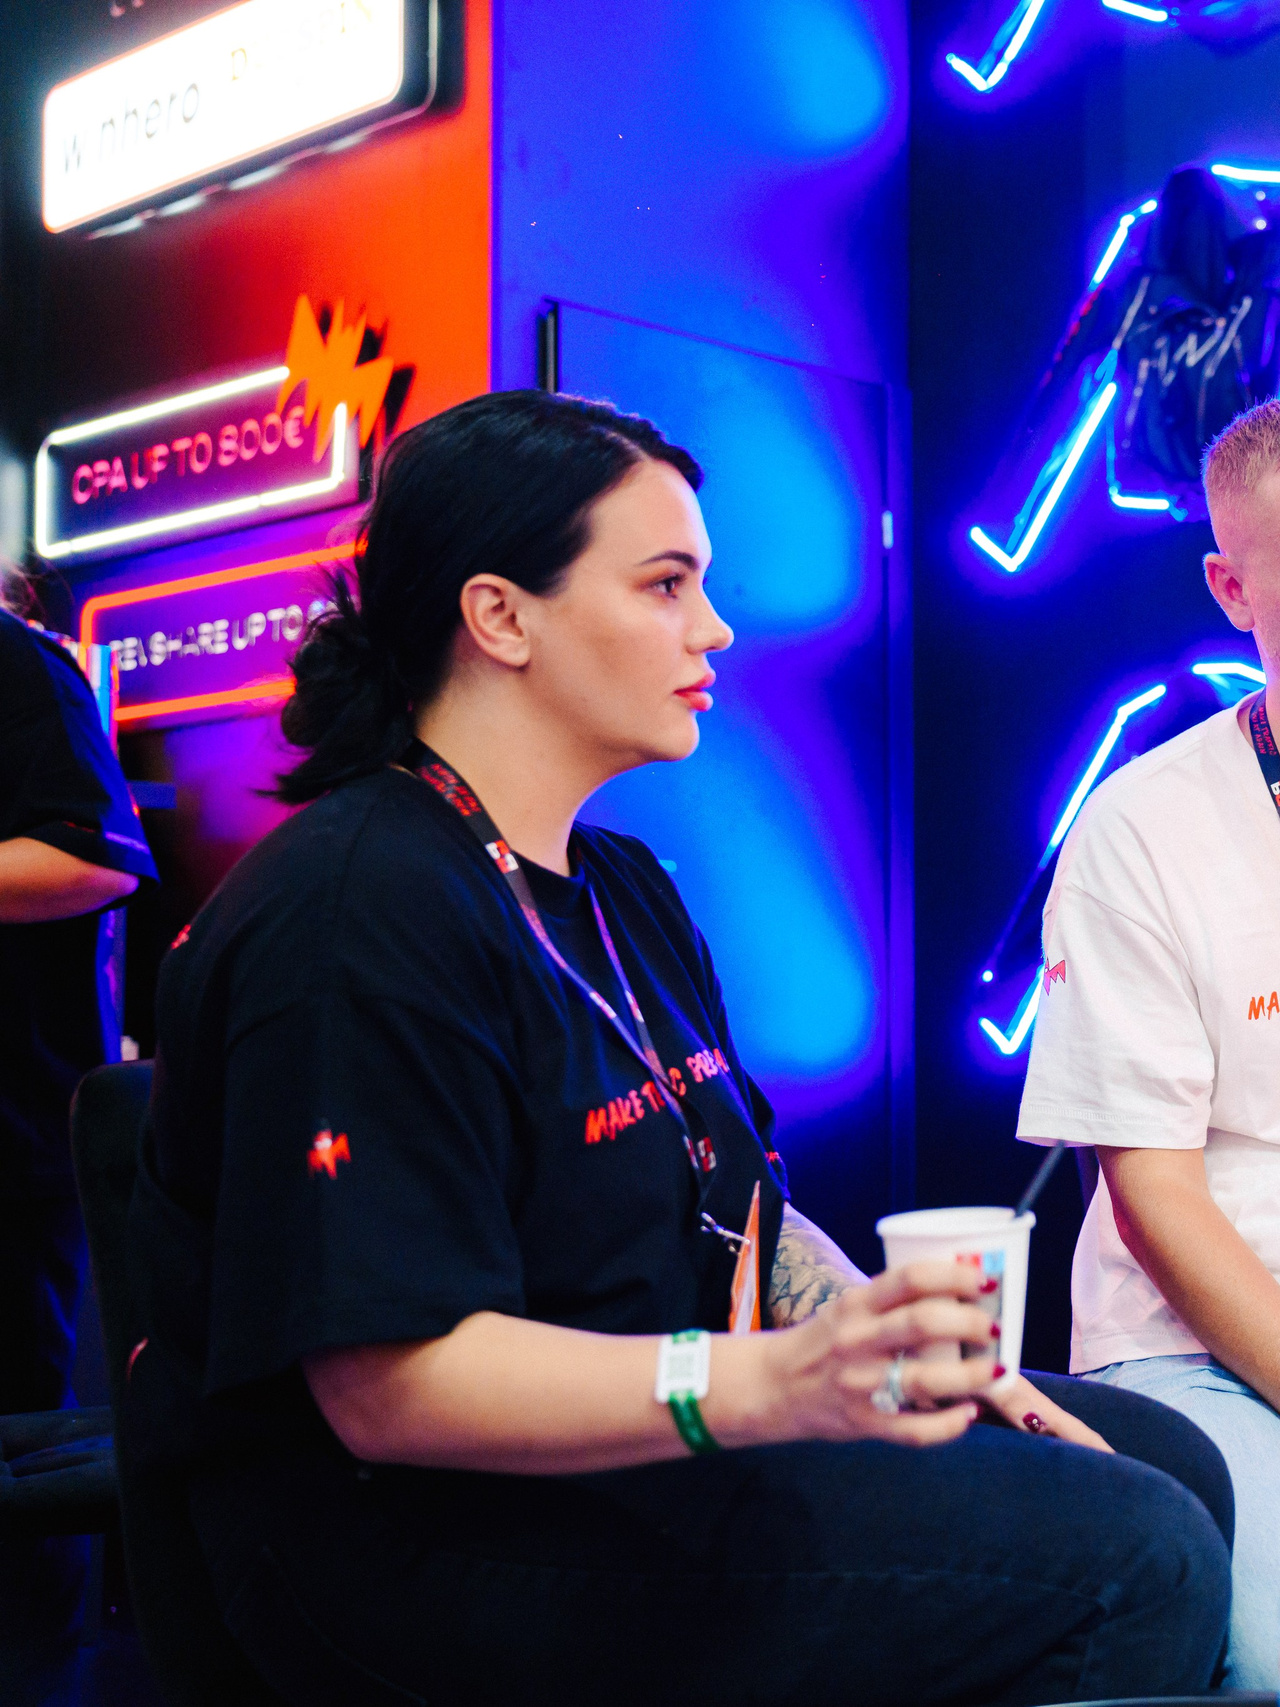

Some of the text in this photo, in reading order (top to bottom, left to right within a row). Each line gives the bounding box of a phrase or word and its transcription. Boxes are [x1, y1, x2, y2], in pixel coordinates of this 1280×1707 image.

[72, 456, 128, 504] CPA
[130, 444, 169, 490] UP
[171, 432, 213, 477] TO
[149, 619, 229, 666] SHARE
[232, 612, 267, 650] UP
[266, 604, 304, 642] TO
[585, 1089, 645, 1144] MAKE
